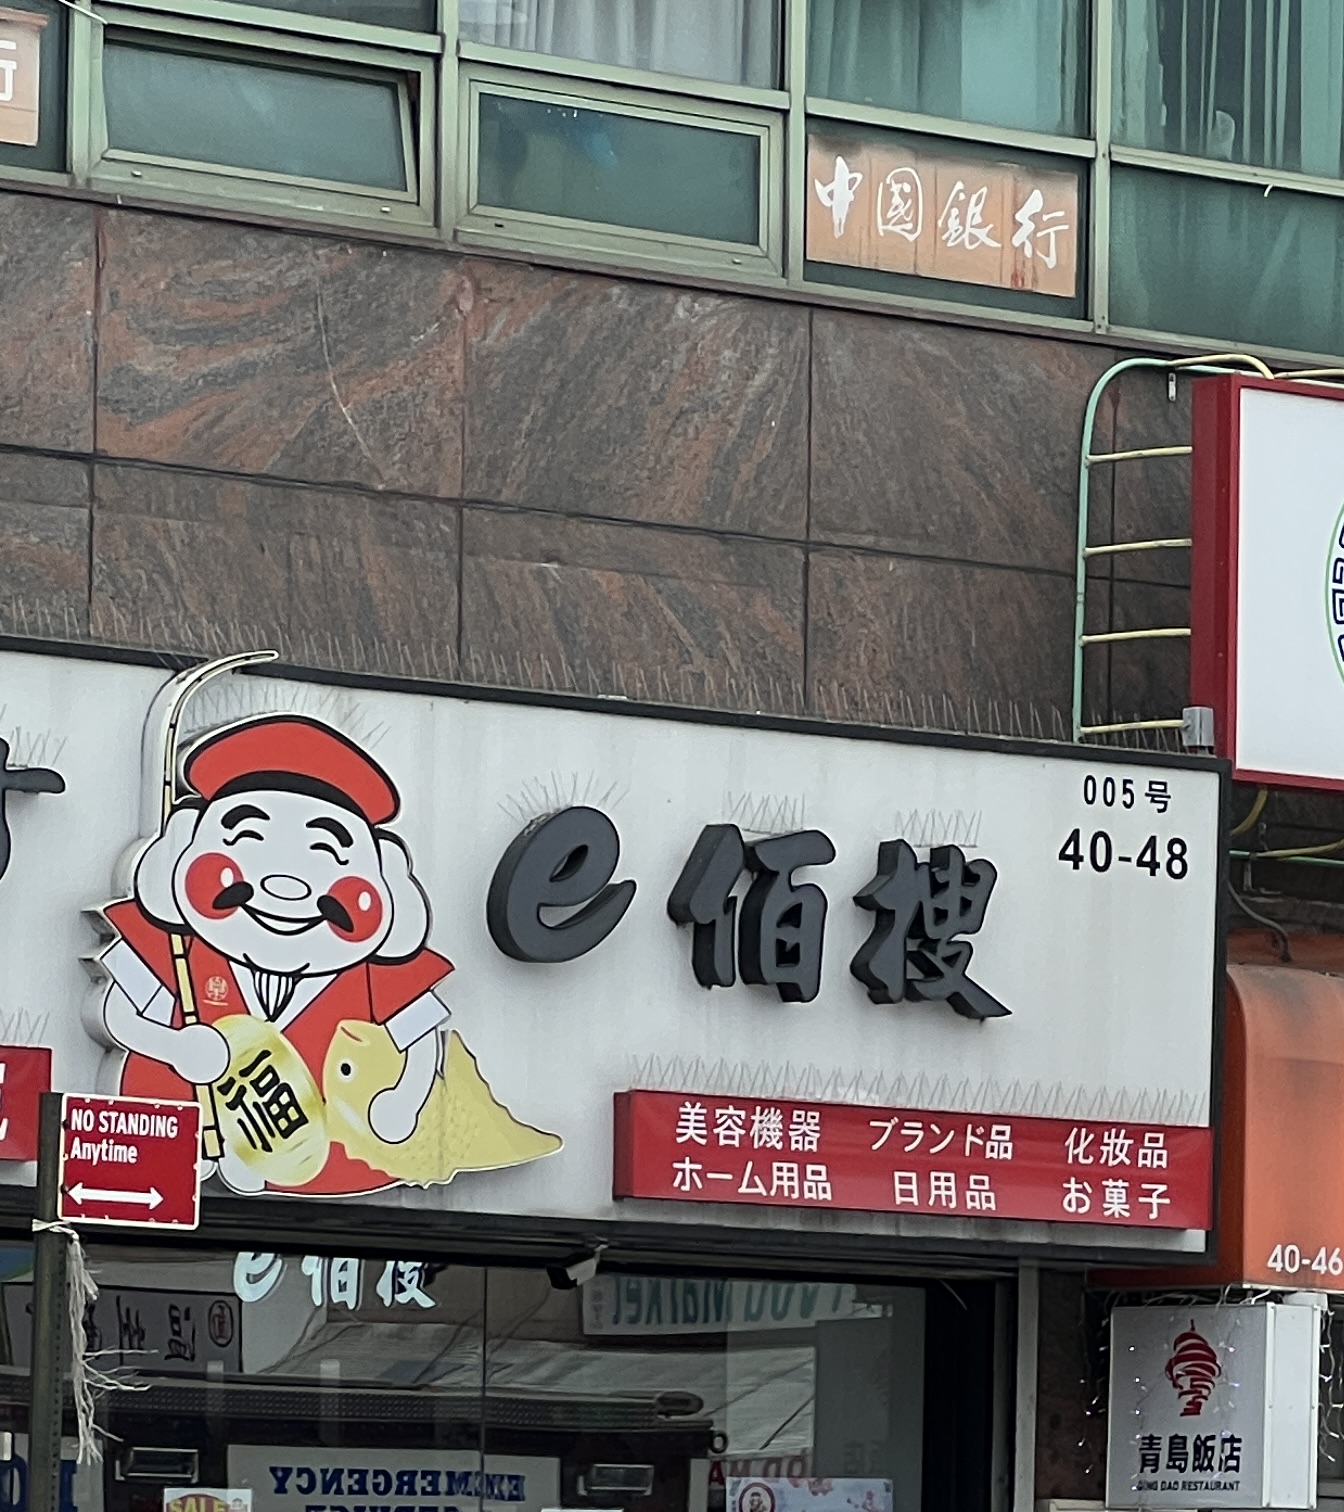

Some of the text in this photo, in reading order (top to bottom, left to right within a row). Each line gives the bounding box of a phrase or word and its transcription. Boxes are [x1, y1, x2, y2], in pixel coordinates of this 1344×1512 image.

[814, 155, 1070, 269] 中國銀行
[1082, 774, 1172, 814] 005号
[1058, 828, 1190, 880] 40-48
[71, 1108, 179, 1138] NO STANDING
[676, 1102, 822, 1153] 美容機器
[868, 1116, 1014, 1161] ブランド品
[70, 1136, 138, 1166] Anytime
[672, 1156, 1171, 1220] ホーム用品 日用品 お菓子
[1267, 1245, 1344, 1277] 40-46
[1138, 1433, 1243, 1474] 青島飯店
[1160, 1480, 1179, 1491] DAO
[1181, 1480, 1240, 1491] RESTAURANT
